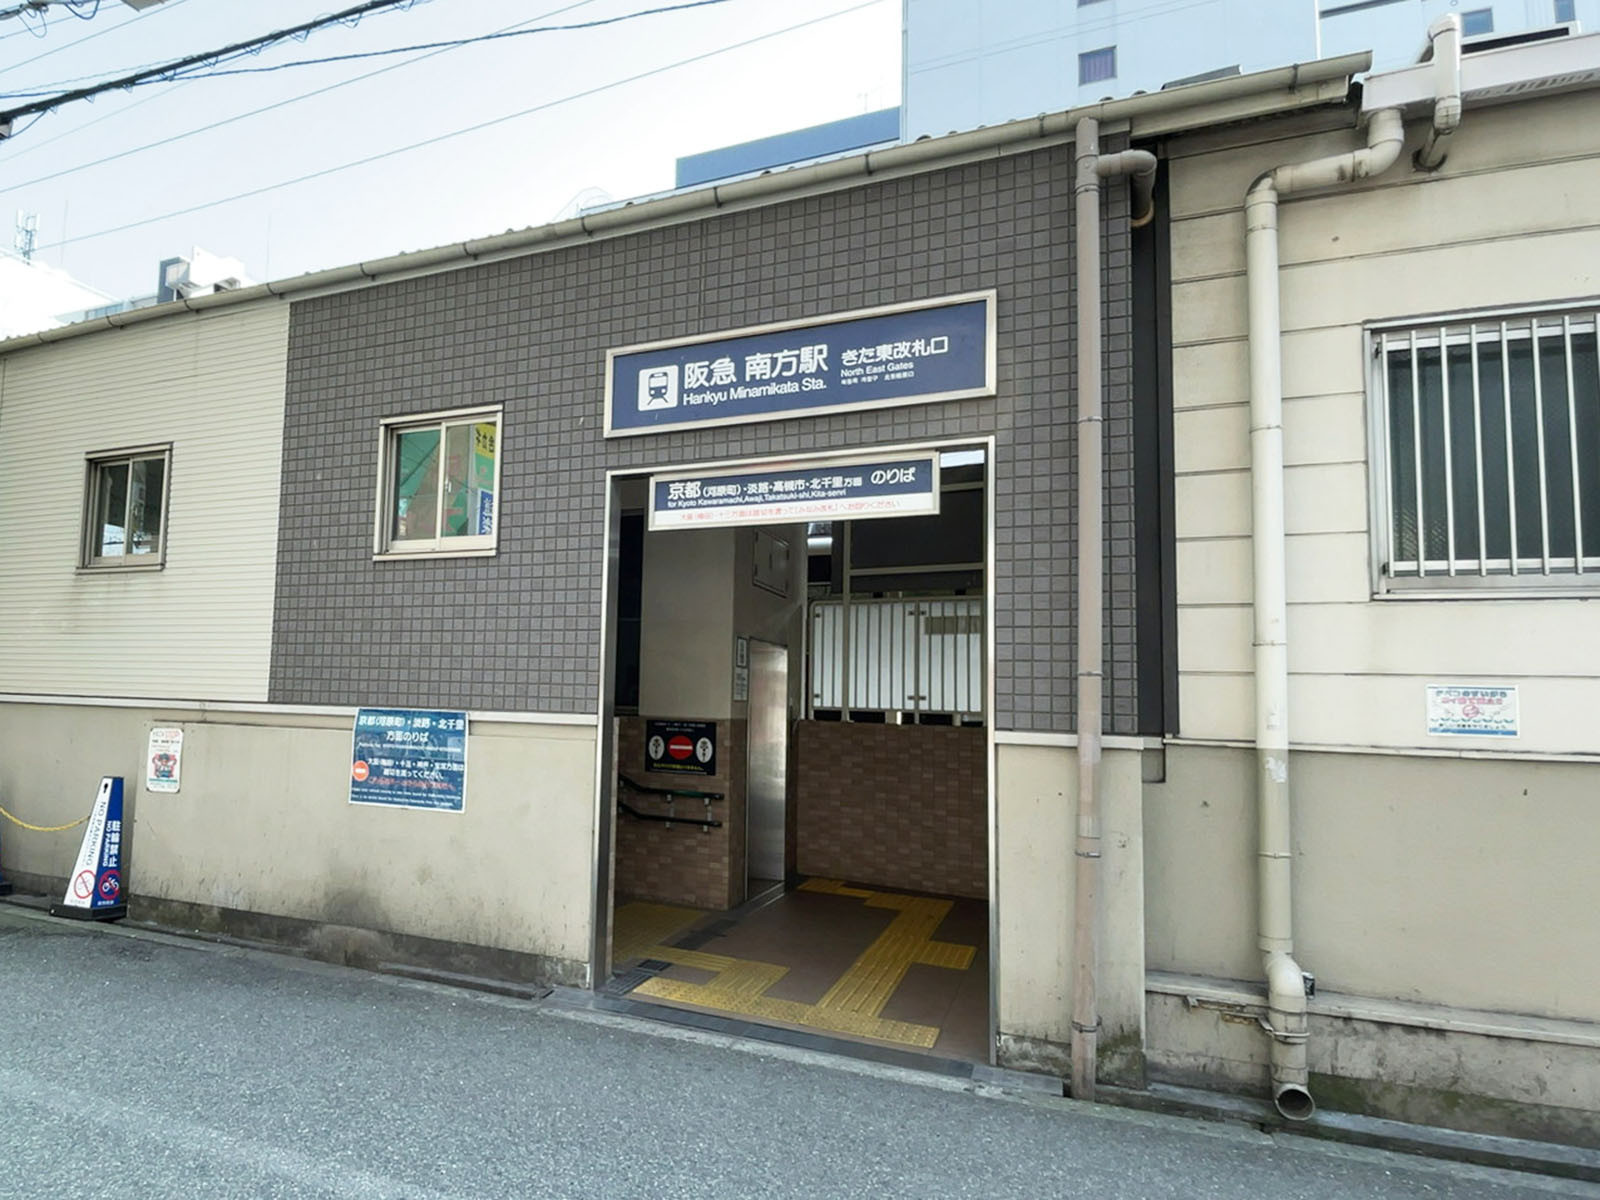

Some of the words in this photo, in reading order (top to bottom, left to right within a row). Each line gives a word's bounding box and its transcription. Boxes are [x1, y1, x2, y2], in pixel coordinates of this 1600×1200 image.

[841, 336, 948, 366] きた東改札口
[684, 357, 737, 390] 阪急
[745, 344, 829, 382] 南方駅
[840, 367, 865, 377] North
[866, 363, 885, 374] East
[887, 361, 914, 372] Gates
[683, 391, 728, 406] Hankyu
[729, 382, 799, 400] Minamikata
[801, 377, 827, 391] Sta.
[871, 467, 917, 485] のりば
[678, 499, 697, 508] Kyoto
[98, 801, 107, 817] NO
[86, 819, 103, 866] PARKING
